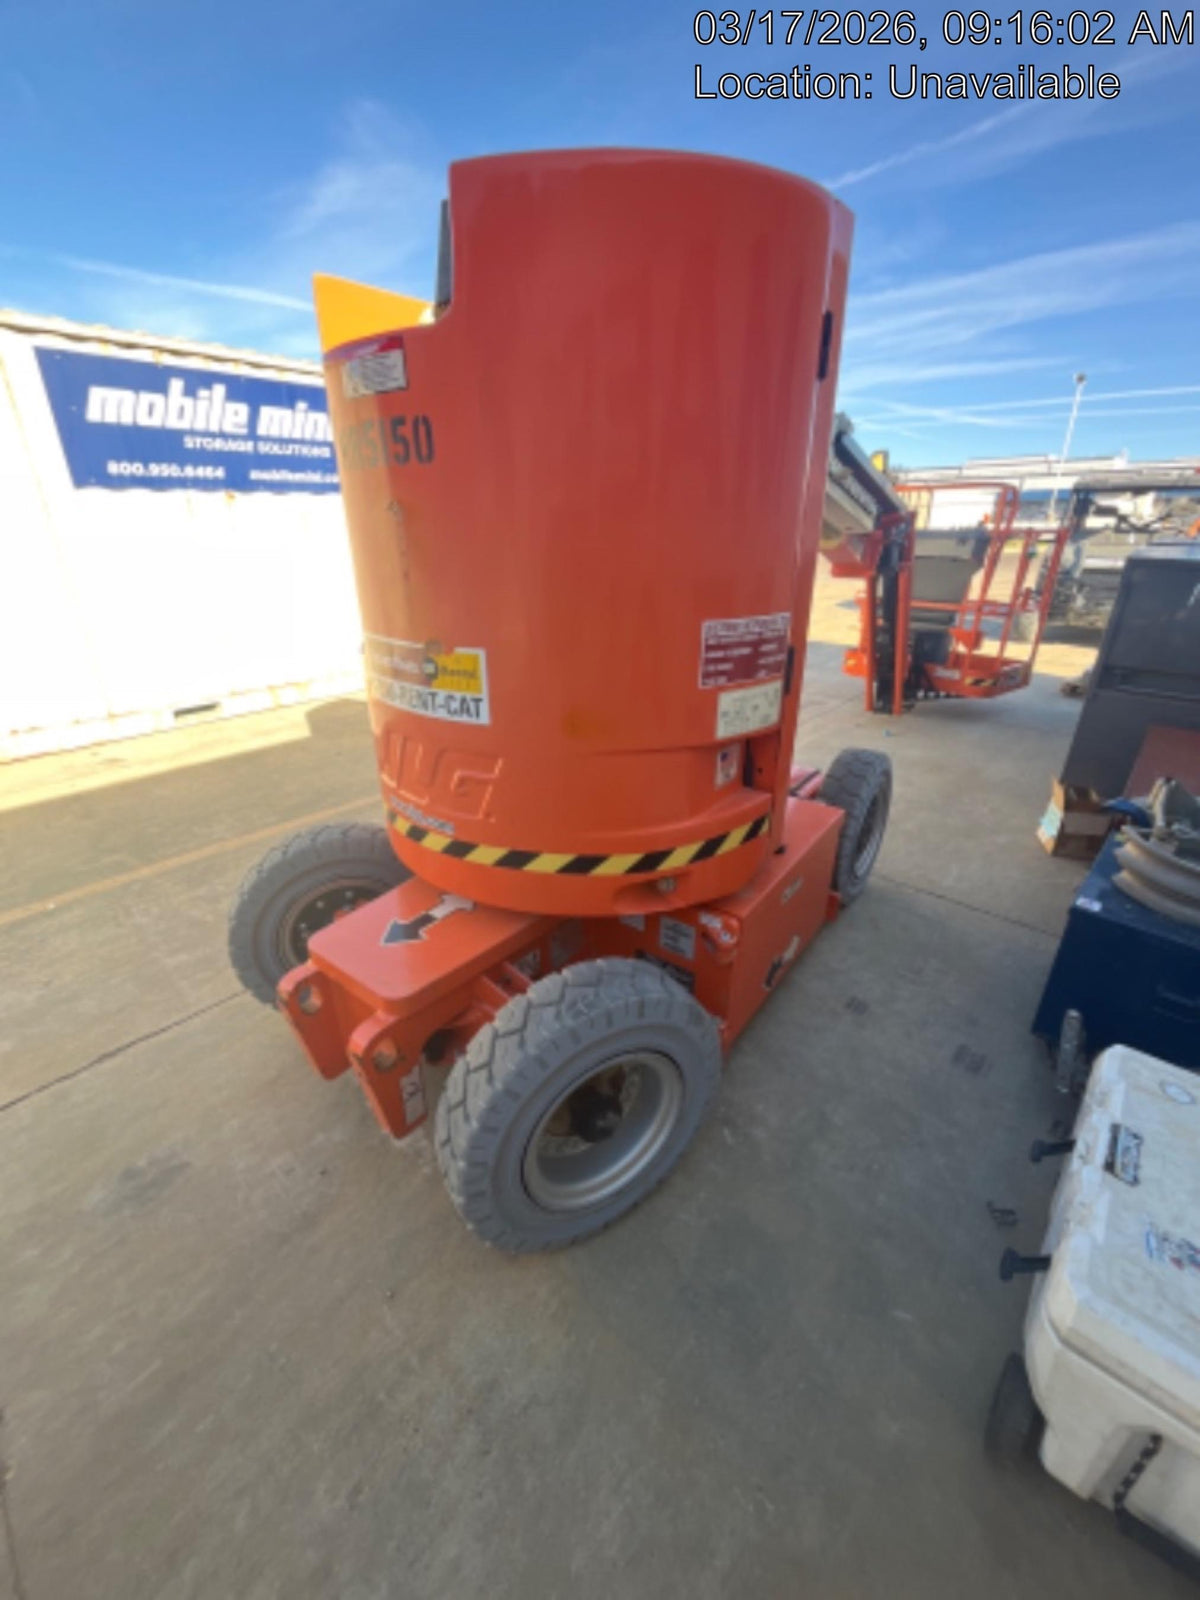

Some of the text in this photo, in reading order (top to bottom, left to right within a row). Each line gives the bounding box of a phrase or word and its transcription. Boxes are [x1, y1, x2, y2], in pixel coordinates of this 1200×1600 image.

[86, 377, 249, 435] mobile
[183, 434, 331, 458] STORAGE SOLUTIONS
